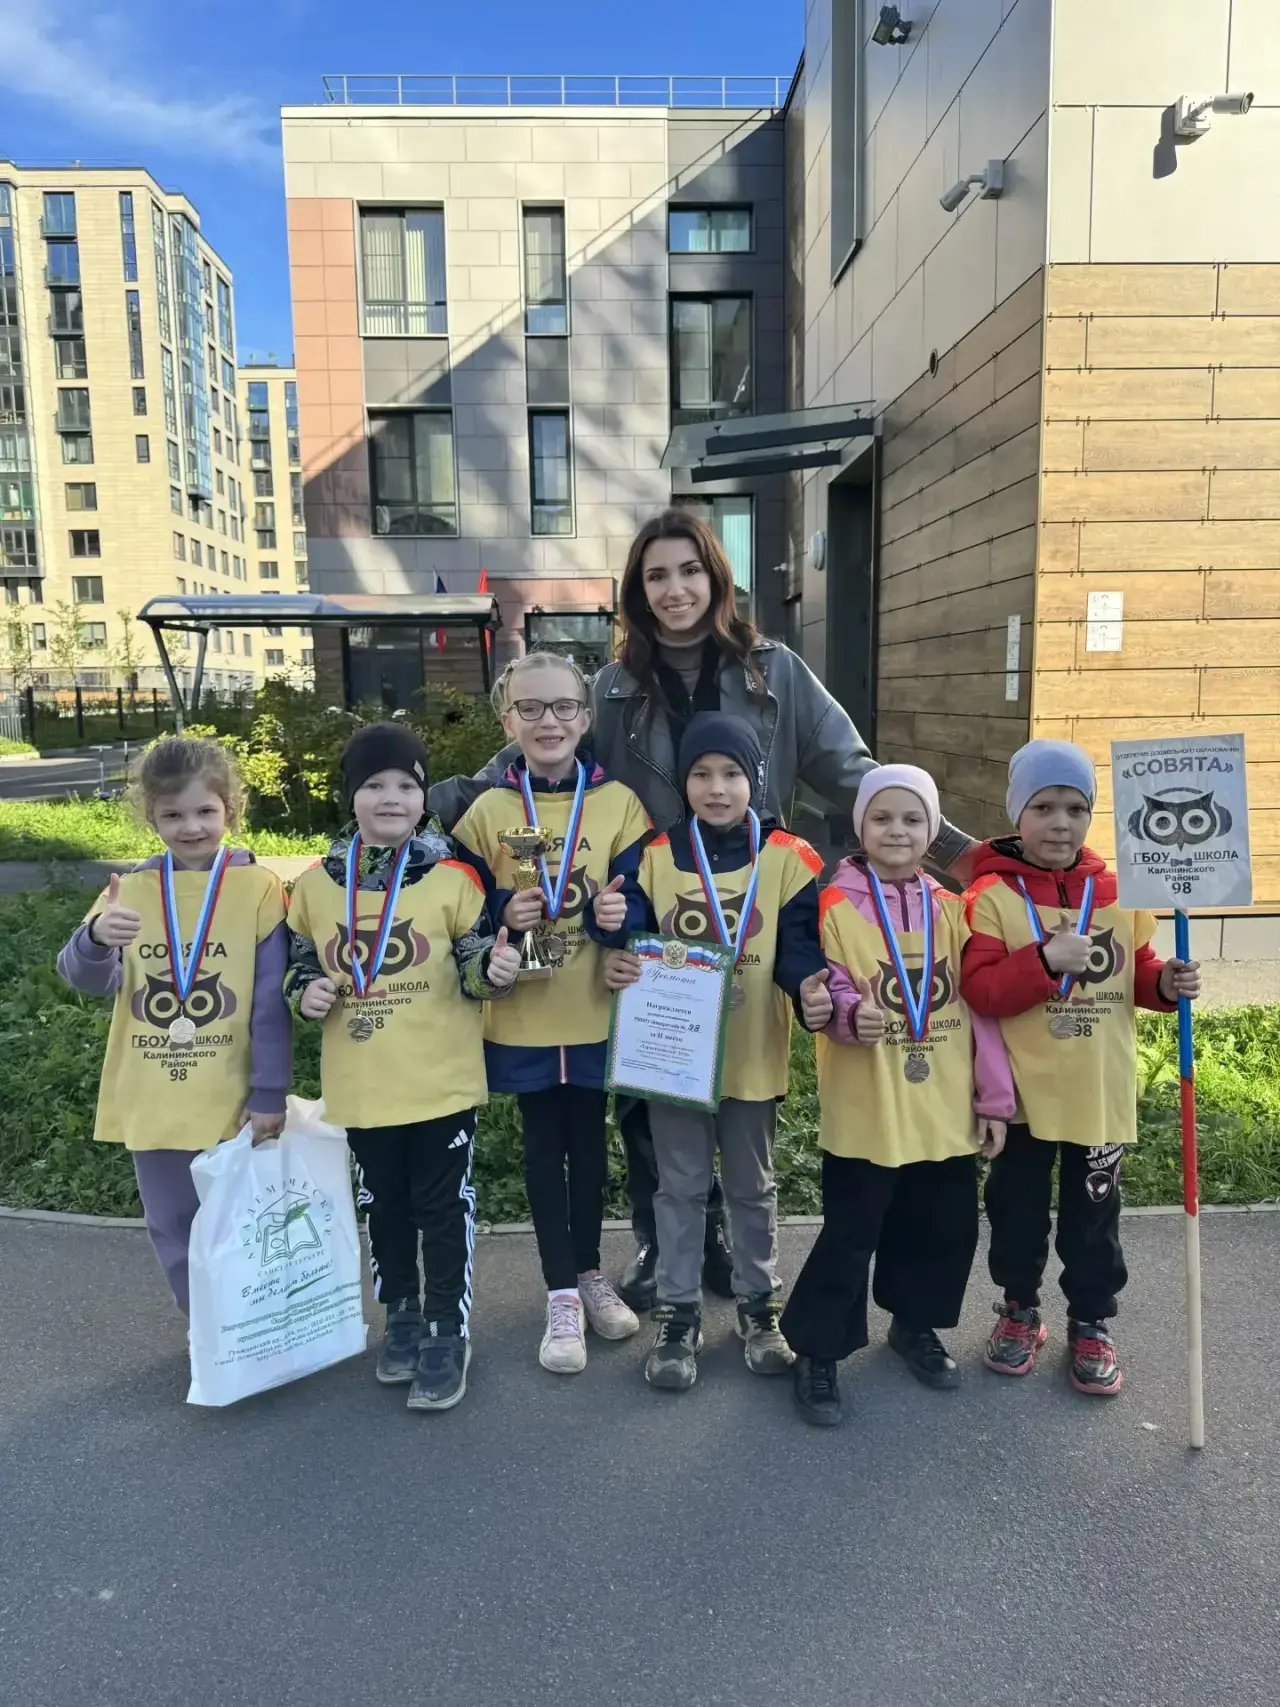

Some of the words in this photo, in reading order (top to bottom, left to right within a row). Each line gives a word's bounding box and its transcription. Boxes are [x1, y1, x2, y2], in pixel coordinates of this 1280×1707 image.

[1121, 756, 1234, 779] «СОВЯТА»
[1133, 851, 1170, 863] ГБОУ
[1193, 850, 1239, 861] ШКОЛА
[1147, 865, 1215, 875] Калининского
[1164, 873, 1200, 882] Района
[1171, 881, 1192, 895] 98
[740, 953, 761, 964] ОЛА
[388, 980, 430, 993] ШКОЛА
[1095, 991, 1124, 1001] ШКОЛА
[1045, 1004, 1112, 1015] Калининского
[930, 1018, 962, 1030] ШКОЛА
[1075, 1014, 1100, 1024] йона
[131, 1034, 170, 1048] ГБОУ
[195, 1034, 234, 1045] ШКОЛА
[143, 1049, 217, 1060] Калининского
[160, 1059, 198, 1069] Района
[169, 1068, 188, 1082] 98
[241, 1277, 280, 1299] Вместе
